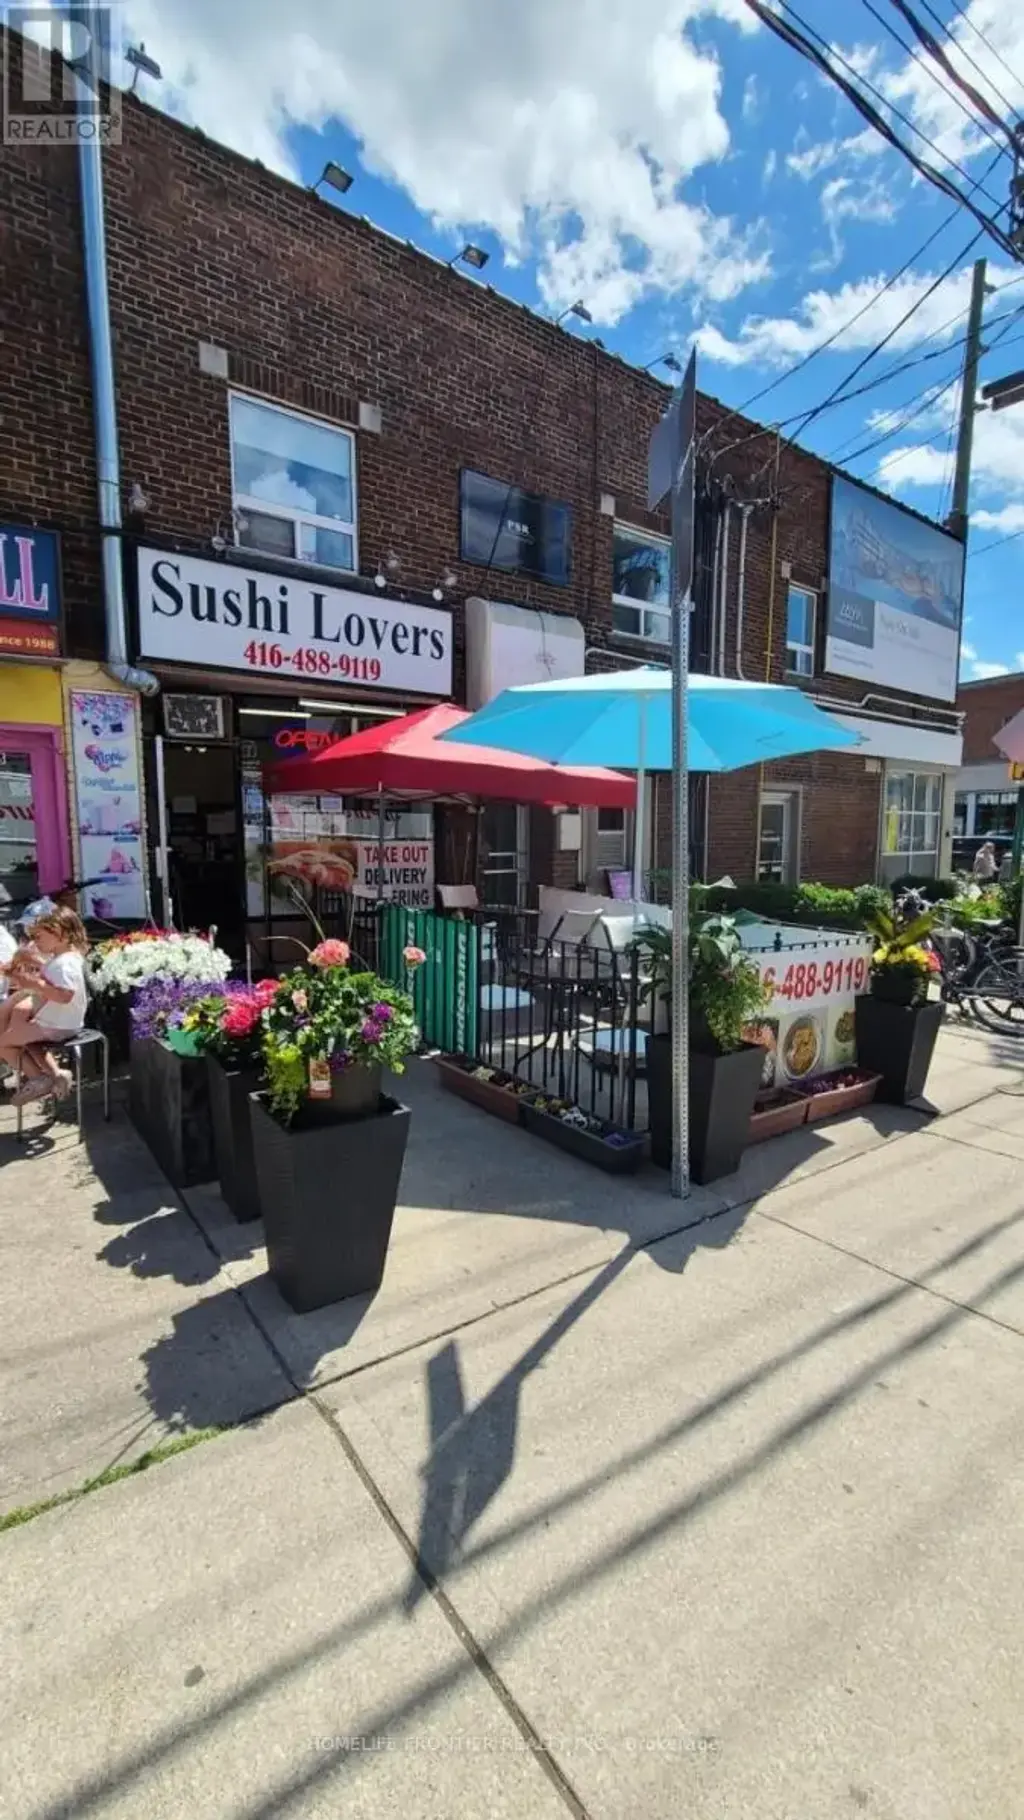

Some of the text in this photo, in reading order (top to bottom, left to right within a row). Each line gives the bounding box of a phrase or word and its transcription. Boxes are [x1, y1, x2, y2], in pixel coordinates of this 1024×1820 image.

[151, 560, 445, 660] Sushi Lovers
[243, 640, 382, 682] 416-488-9119
[363, 846, 429, 863] TAKE OUT
[364, 867, 427, 885] DELIVERY
